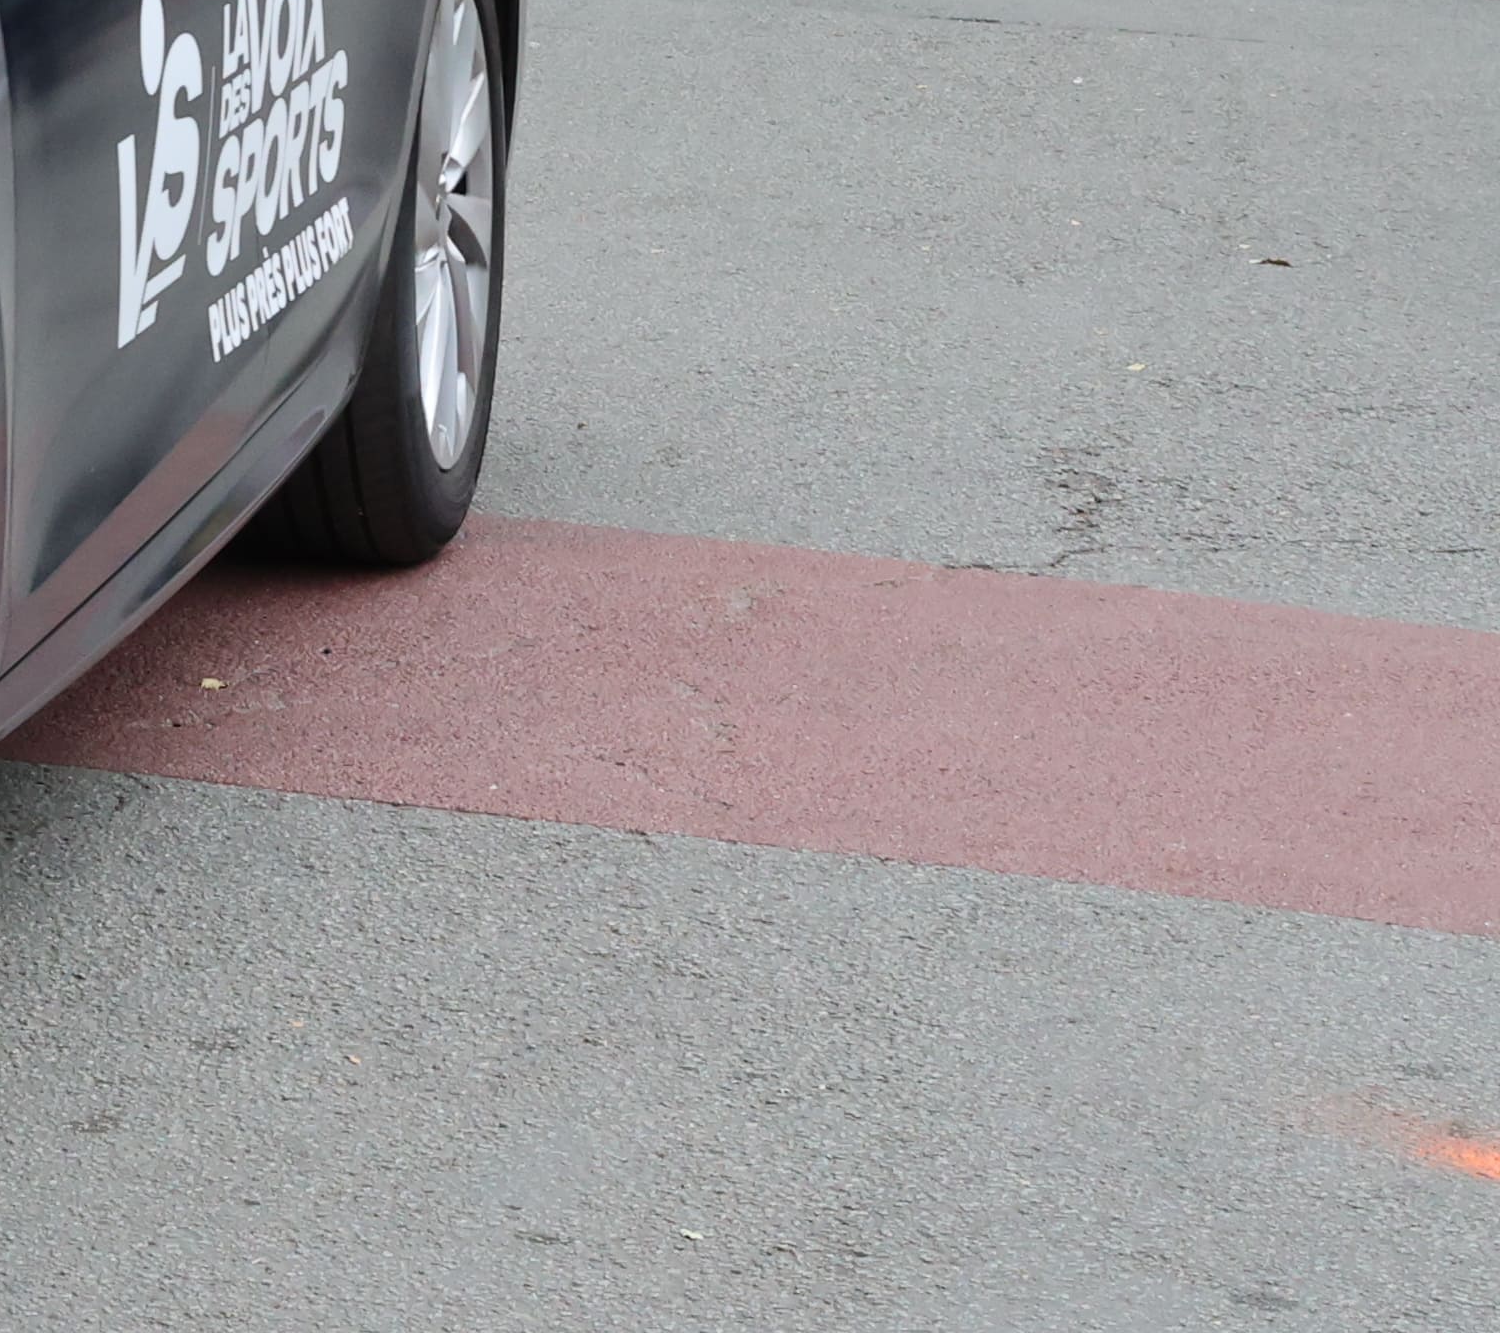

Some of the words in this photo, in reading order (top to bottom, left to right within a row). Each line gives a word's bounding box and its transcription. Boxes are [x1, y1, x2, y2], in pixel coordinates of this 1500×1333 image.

[206, 50, 349, 277] SPORTS
[219, 67, 253, 139] DES
[208, 282, 252, 363] PLUS
[248, 247, 284, 333] PRÈS
[282, 223, 324, 305] PLUS
[318, 197, 355, 273] FORT
